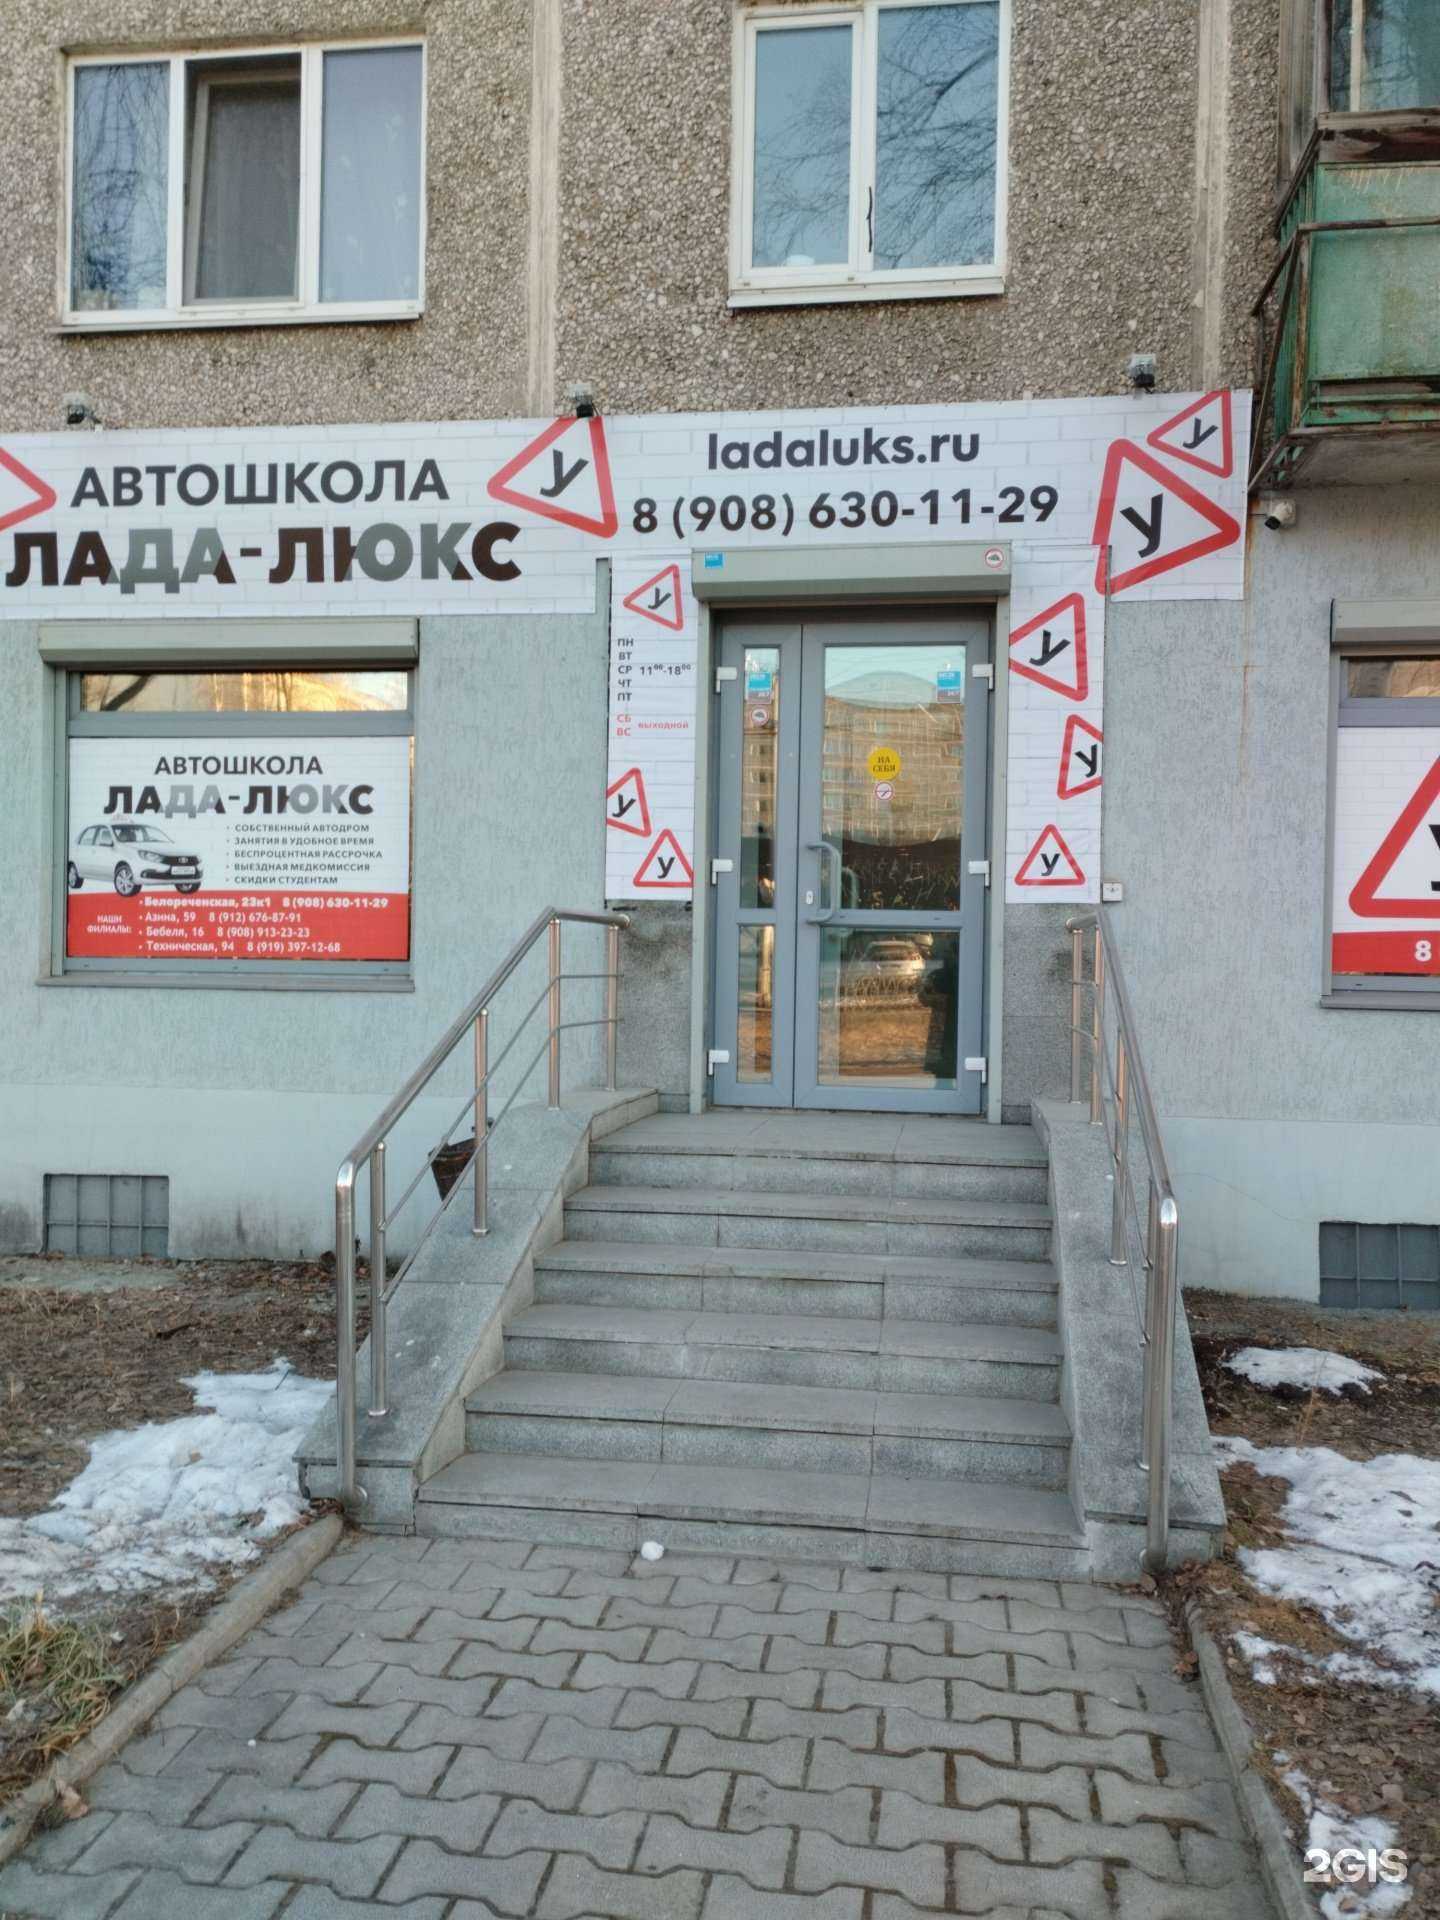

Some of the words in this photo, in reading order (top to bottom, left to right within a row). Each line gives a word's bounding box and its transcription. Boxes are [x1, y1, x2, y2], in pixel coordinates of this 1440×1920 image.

[1182, 418, 1219, 450] У
[707, 427, 980, 470] ladaluks.ru
[539, 449, 589, 498] У
[70, 458, 450, 508] АВТОШКОЛА
[632, 497, 658, 534] 8
[672, 492, 794, 539] (908)
[808, 484, 1059, 530] 630-11-29
[1120, 493, 1164, 558] У
[5, 520, 522, 594] ЛАДА-ЛЮКС
[648, 587, 672, 611] У
[617, 638, 634, 647] ПН
[1028, 629, 1071, 667] У
[618, 652, 632, 660] ВТ
[618, 665, 632, 674] СР
[618, 679, 632, 688] ЧТ
[617, 692, 632, 701] ПТ
[616, 714, 631, 723] СБ
[616, 727, 631, 736] ВС
[154, 756, 323, 776] АВТОШКОЛА
[877, 756, 890, 764] НА
[1074, 744, 1098, 778] У
[103, 784, 374, 819] ЛАДА-ЛЮКС
[612, 794, 636, 818] У
[235, 823, 311, 833] СОБСТВЕННЫЙ
[312, 824, 370, 833] АВТОДРОМ
[234, 837, 280, 846] ЗАНЯТИЯ
[290, 837, 339, 847] УДОБНОЕ
[340, 837, 375, 845] ВРЕМЯ
[234, 850, 321, 860] БЕСПРОЦЕНТНАЯ
[322, 850, 383, 859] РАССРОЧКА
[234, 863, 289, 872] ВЫЕЗДНАЯ
[290, 863, 371, 872] МЕДКОМИССИЯ
[657, 856, 676, 879] У
[1040, 852, 1061, 877] У
[234, 876, 276, 885] СКИДКИ
[278, 876, 339, 885] СТУДЕНТАМ
[97, 915, 123, 924] НАШИ
[145, 911, 180, 923] Азина,
[183, 911, 196, 922] 59
[209, 912, 215, 922] 8
[218, 911, 247, 924] (912)
[248, 912, 301, 923] 676-87-91
[191, 927, 205, 937] 16
[217, 927, 224, 937] 8
[226, 927, 254, 939] (908)
[256, 927, 310, 938] 913-23-23
[146, 940, 218, 953] Техническая,
[221, 941, 235, 951] 94
[247, 941, 254, 952] 8
[256, 941, 285, 954] (919)
[287, 942, 341, 953] 397-12-68
[1415, 939, 1432, 962] 8
